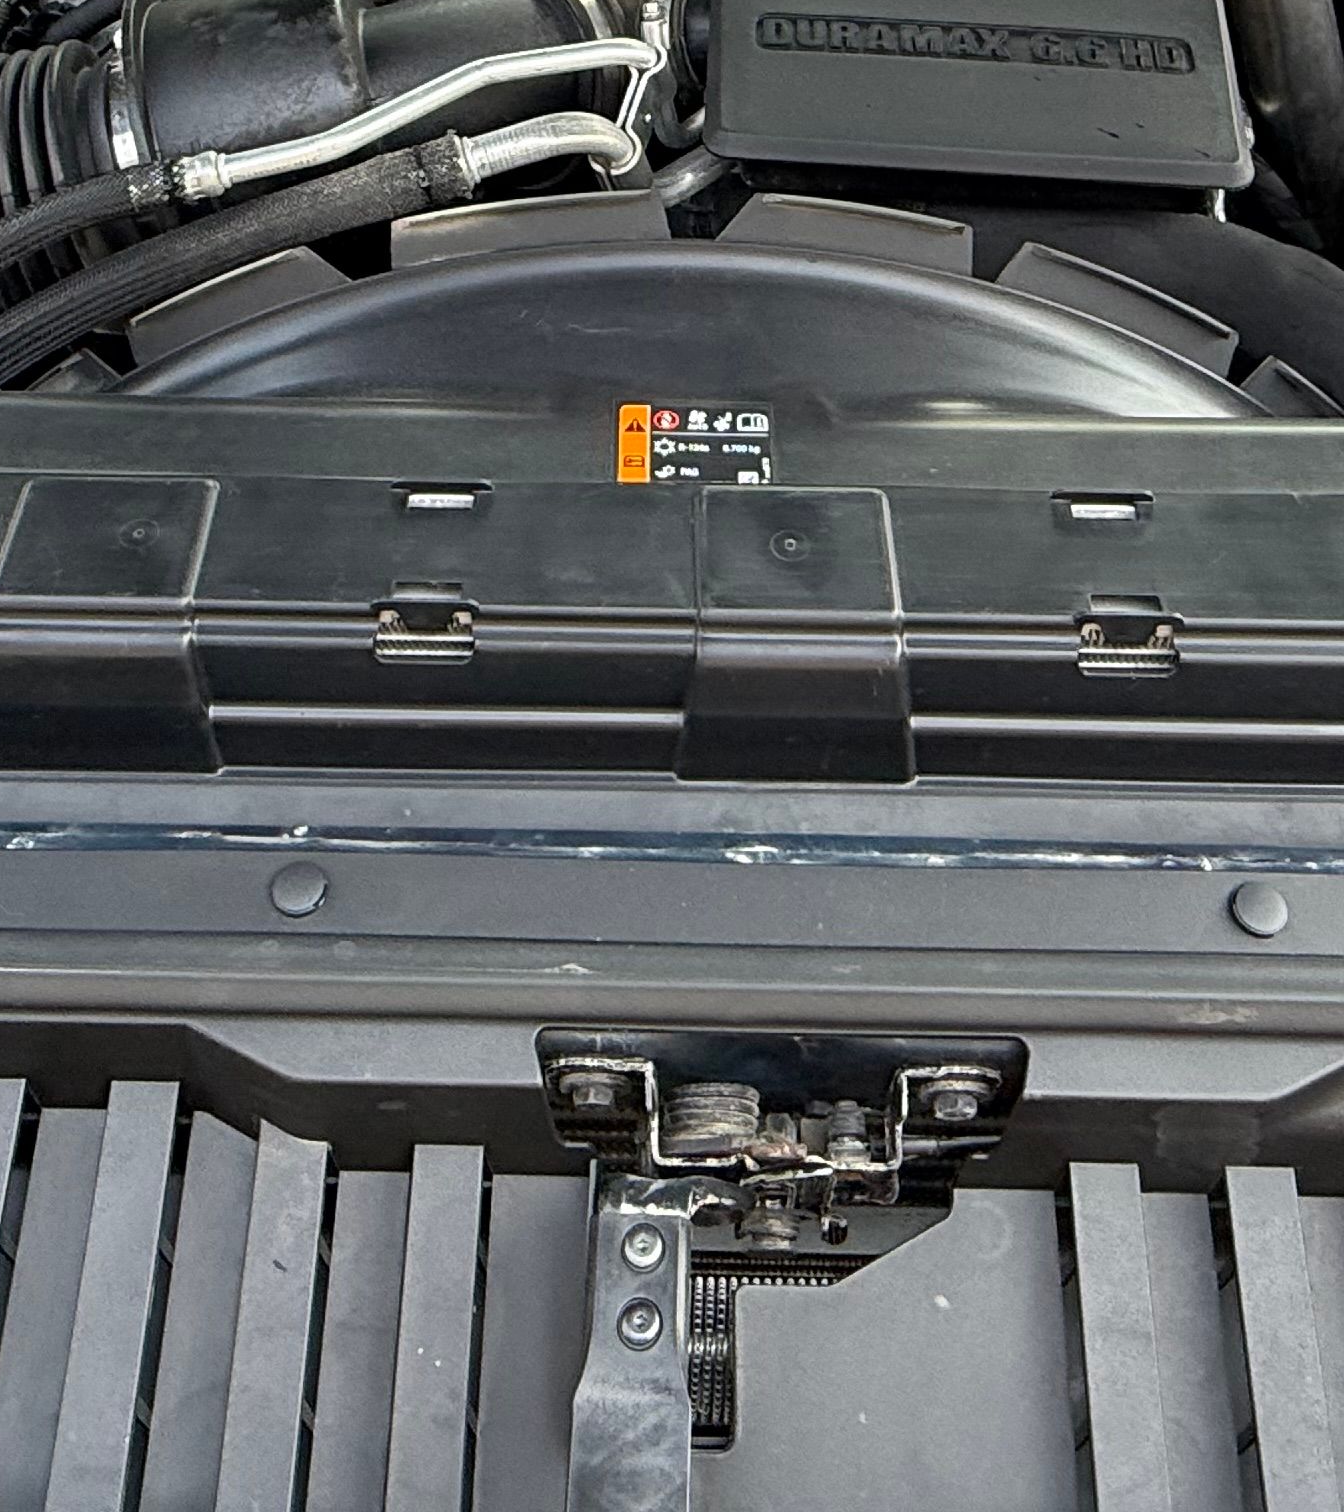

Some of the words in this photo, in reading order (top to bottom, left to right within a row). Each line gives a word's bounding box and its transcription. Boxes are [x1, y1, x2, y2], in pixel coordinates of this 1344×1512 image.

[762, 16, 1010, 60] DURAMAX
[1030, 35, 1110, 69] 6.6
[1119, 39, 1191, 74] HD
